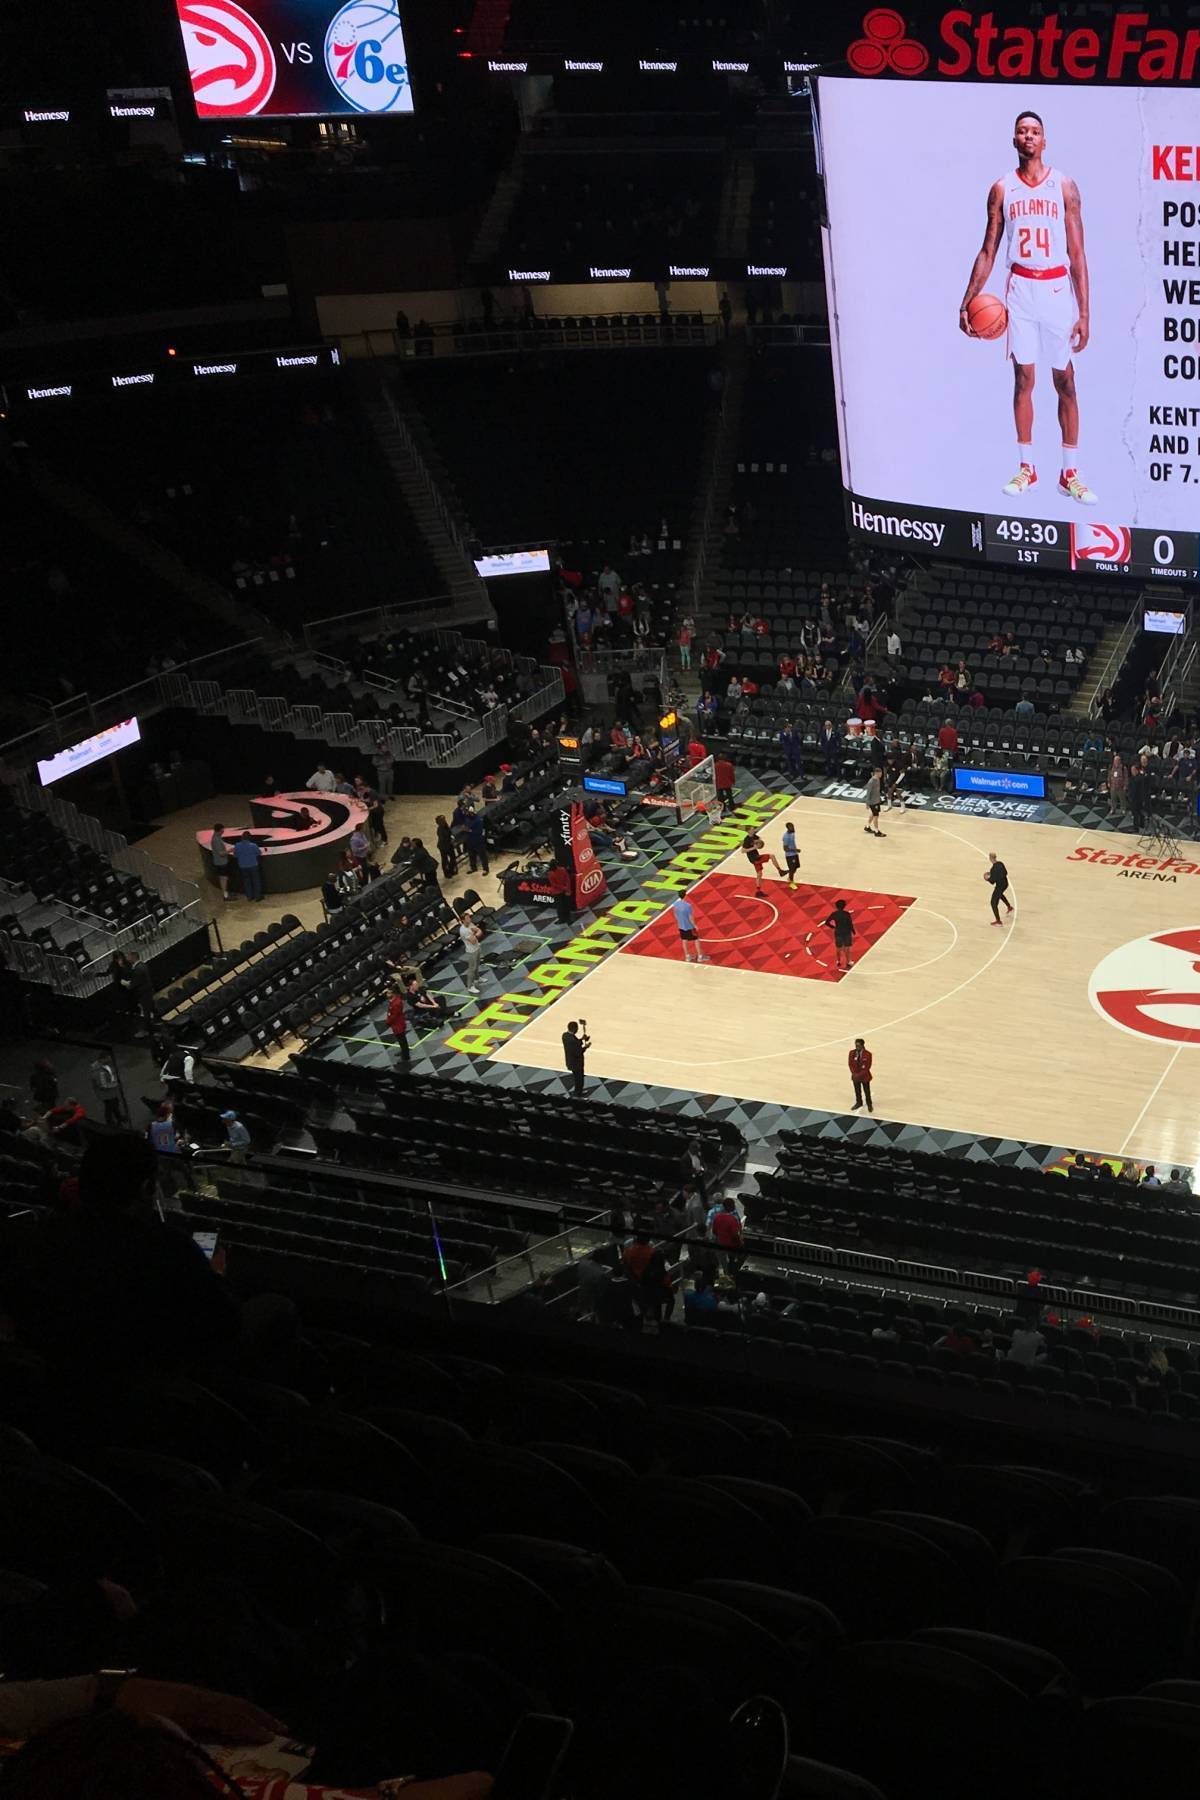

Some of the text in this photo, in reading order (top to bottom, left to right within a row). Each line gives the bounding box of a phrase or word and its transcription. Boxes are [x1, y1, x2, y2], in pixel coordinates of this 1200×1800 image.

[280, 42, 314, 64] VS
[487, 60, 528, 73] Hennessy
[564, 59, 604, 72] Hennessy
[638, 60, 678, 72] Hennessy
[712, 60, 750, 73] Hennessy
[24, 110, 70, 122] Hennessy
[109, 106, 156, 118] Hennessy
[1009, 199, 1059, 221] ATLANTA
[1018, 228, 1050, 258] 24
[508, 269, 551, 281] Hennessy
[589, 267, 632, 279] Hennessy
[669, 265, 710, 278] Hennessy
[747, 265, 788, 277] Hennessy
[275, 355, 318, 367] Hennessy
[193, 363, 237, 376] Hennessy
[111, 373, 155, 387] Hennessy
[27, 385, 72, 400] Hennessy
[1149, 405, 1200, 427] KENT
[1149, 434, 1190, 455] AND
[1149, 462, 1175, 483] OF
[851, 501, 946, 547] Hennessy
[996, 519, 1058, 545] 49:30
[1017, 549, 1039, 563] 1ST
[1153, 535, 1175, 565] 0
[1095, 562, 1129, 573] FOULS 0
[1150, 567, 1198, 578] TIMEOUTS 7
[970, 776, 1002, 787] Walmart
[932, 801, 984, 814] Casino
[937, 795, 1042, 814] CHEROKEE
[583, 873, 601, 892] KIA
[1117, 869, 1177, 884] ARENA
[444, 900, 667, 1055] ATLANTA
